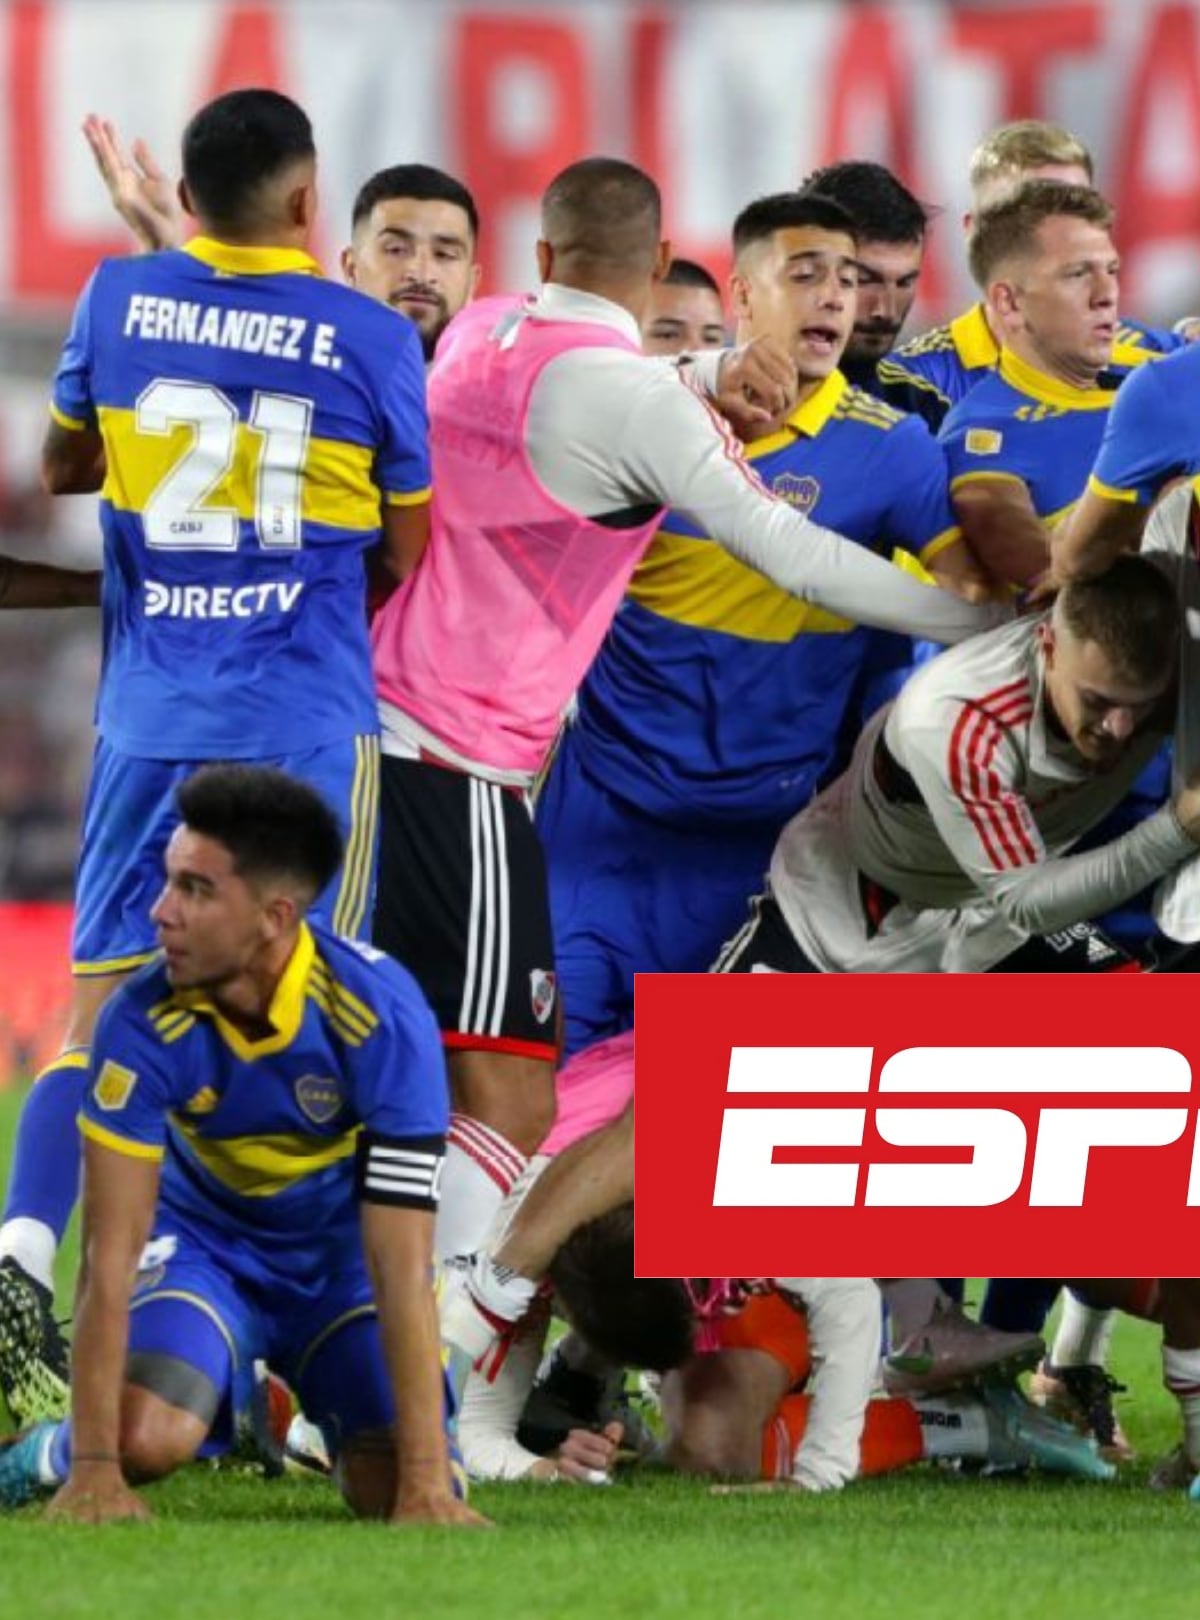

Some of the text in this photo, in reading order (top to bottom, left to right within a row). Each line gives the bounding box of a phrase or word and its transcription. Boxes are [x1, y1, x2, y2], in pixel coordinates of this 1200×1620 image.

[123, 294, 342, 370] FERNANDEZ E.
[135, 376, 315, 551] 21
[144, 580, 303, 619] DIRECTV
